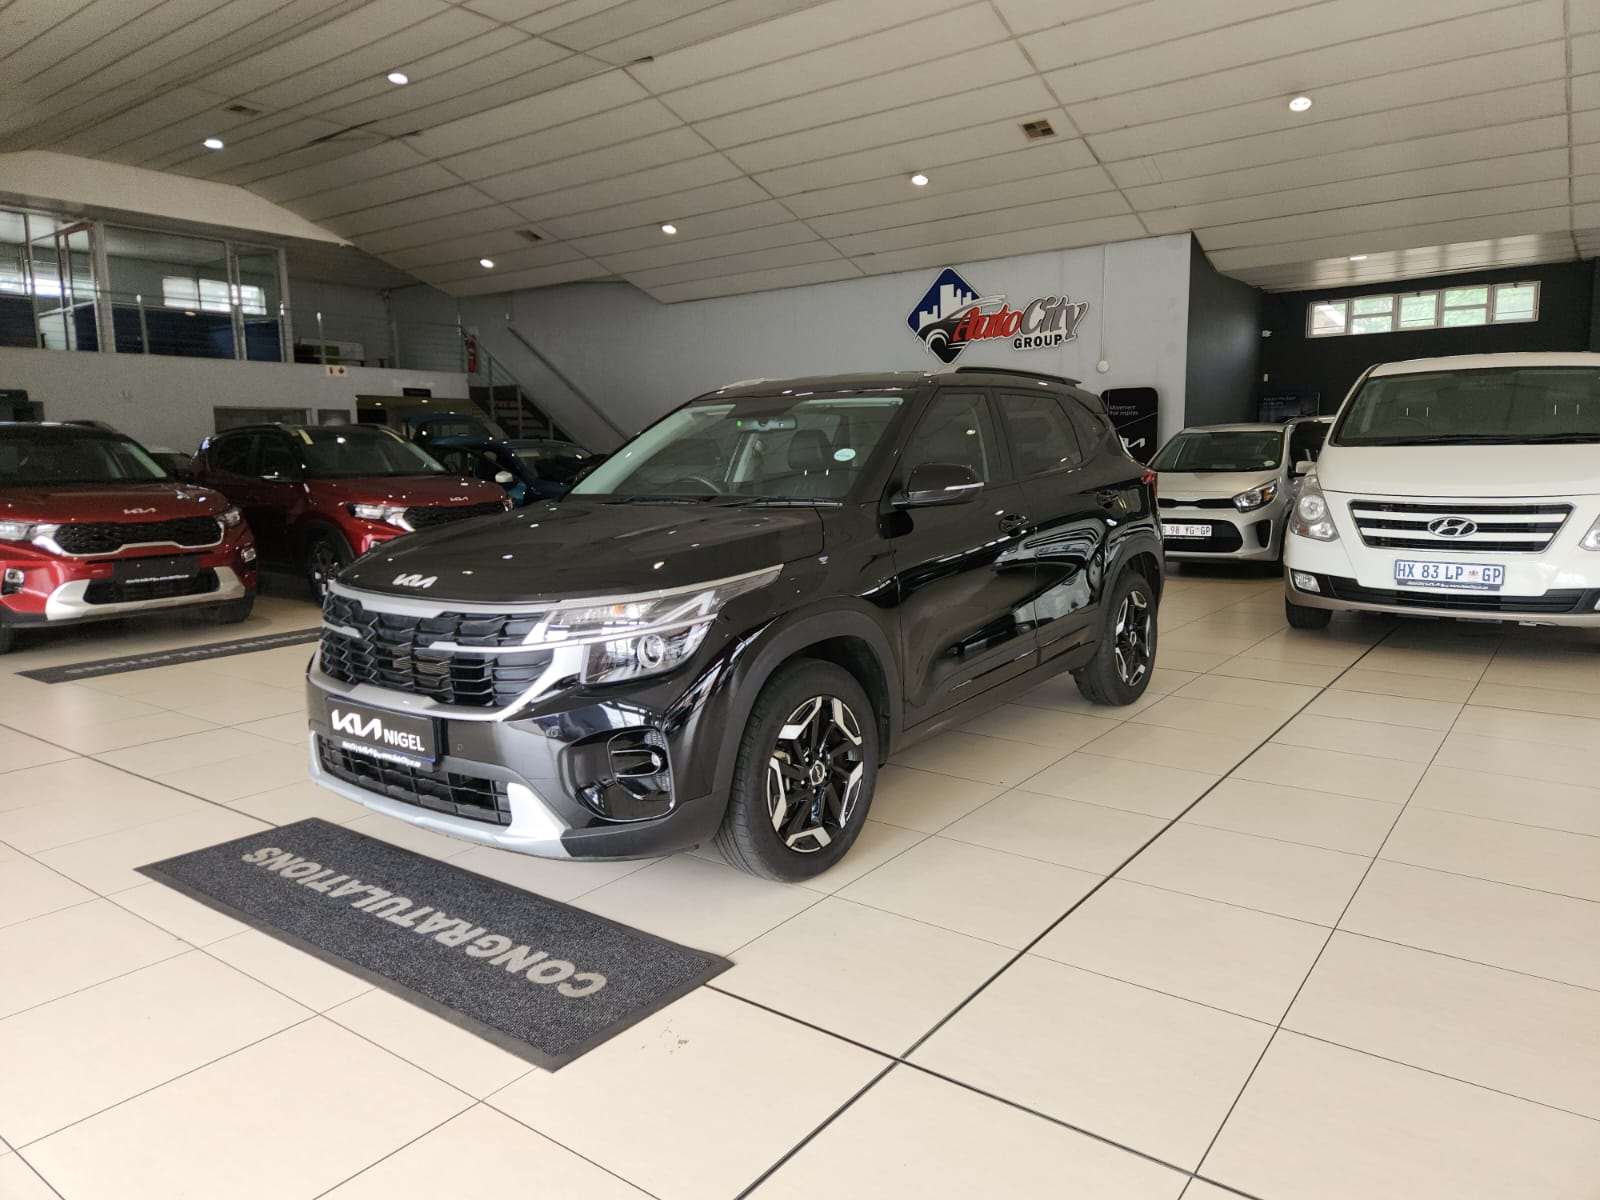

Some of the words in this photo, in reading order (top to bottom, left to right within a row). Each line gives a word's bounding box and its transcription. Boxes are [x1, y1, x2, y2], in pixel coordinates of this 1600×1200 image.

[1013, 334, 1063, 350] GROUP
[392, 573, 438, 589] KIA
[1397, 563, 1415, 578] HX
[1421, 565, 1440, 579] 83
[1445, 566, 1464, 580] LP
[1482, 568, 1501, 583] GP
[331, 709, 382, 740] KIA
[383, 728, 425, 752] NIGEL
[240, 846, 608, 999] CONGRATULATIONS
